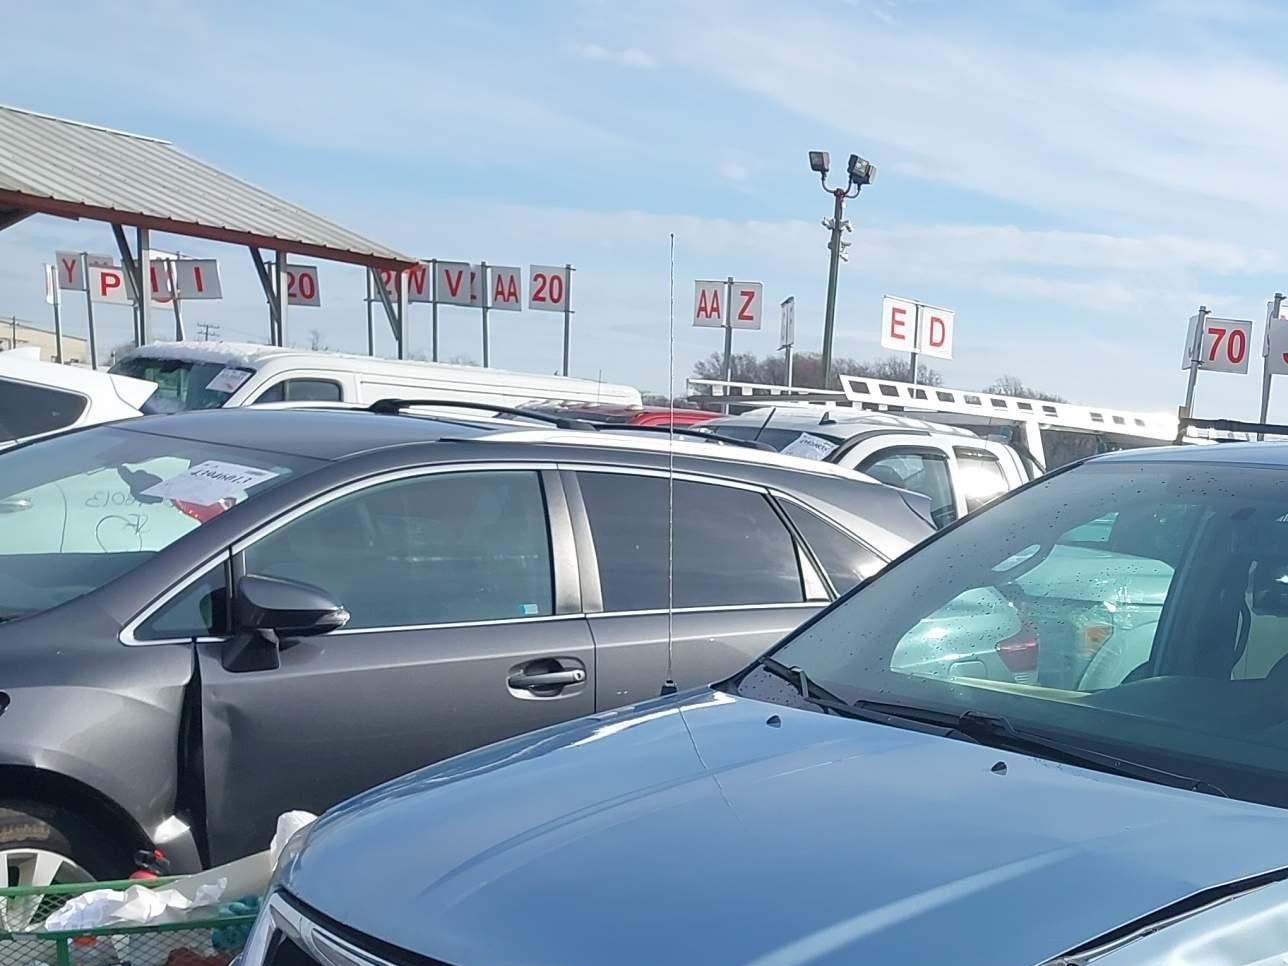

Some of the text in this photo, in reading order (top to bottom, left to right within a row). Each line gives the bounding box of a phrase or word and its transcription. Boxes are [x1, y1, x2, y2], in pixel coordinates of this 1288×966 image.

[62, 258, 76, 283] Y
[100, 272, 121, 296] P
[445, 270, 463, 297] V
[495, 274, 519, 303] AA
[532, 273, 563, 303] 20
[697, 289, 721, 319] AA
[738, 290, 755, 321] Z
[890, 306, 907, 340] E
[929, 316, 946, 347] D
[1207, 328, 1246, 363] 70
